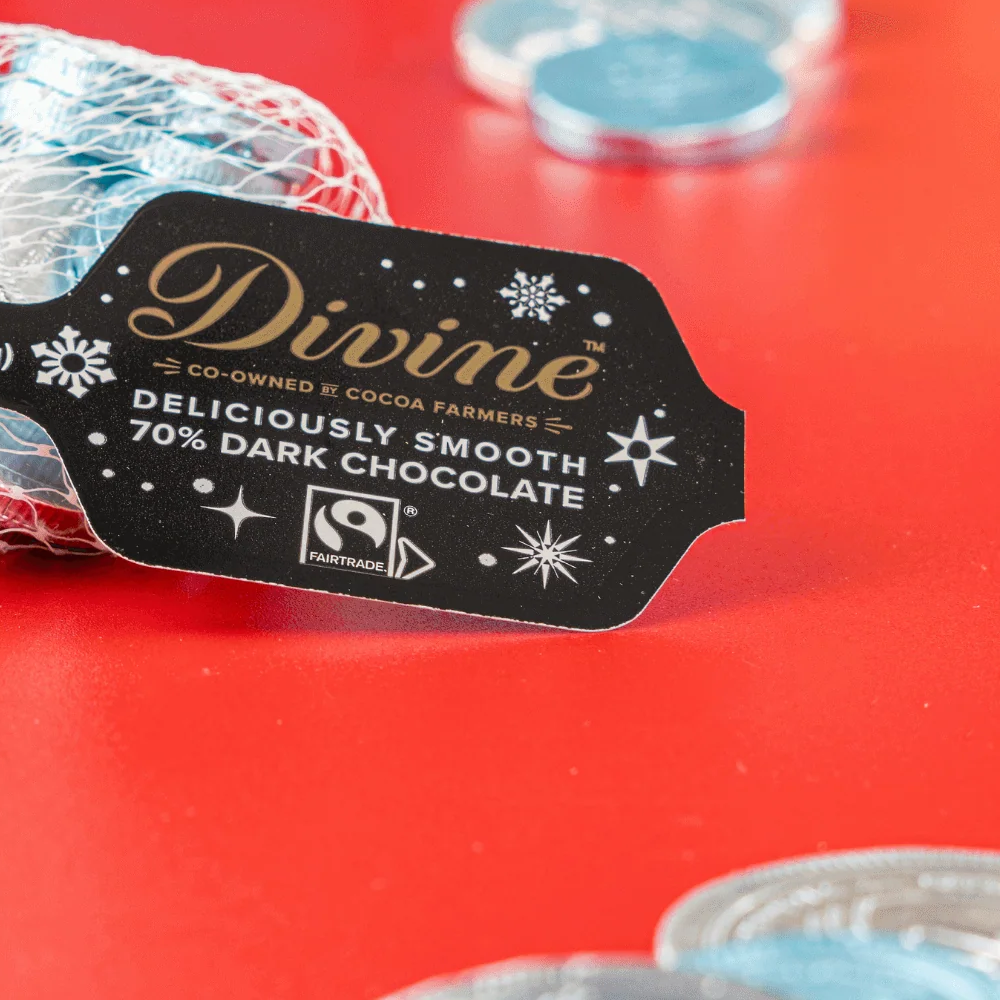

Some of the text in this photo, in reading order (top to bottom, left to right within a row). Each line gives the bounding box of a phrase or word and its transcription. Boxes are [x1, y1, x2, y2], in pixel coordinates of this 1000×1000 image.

[127, 242, 600, 400] Divine
[133, 389, 586, 476] DELICIOUSLY SMOOTH
[187, 363, 538, 428] CO-OWNED BY COCOA FARMERS
[130, 419, 585, 509] 70% DARK CHOCOLATE
